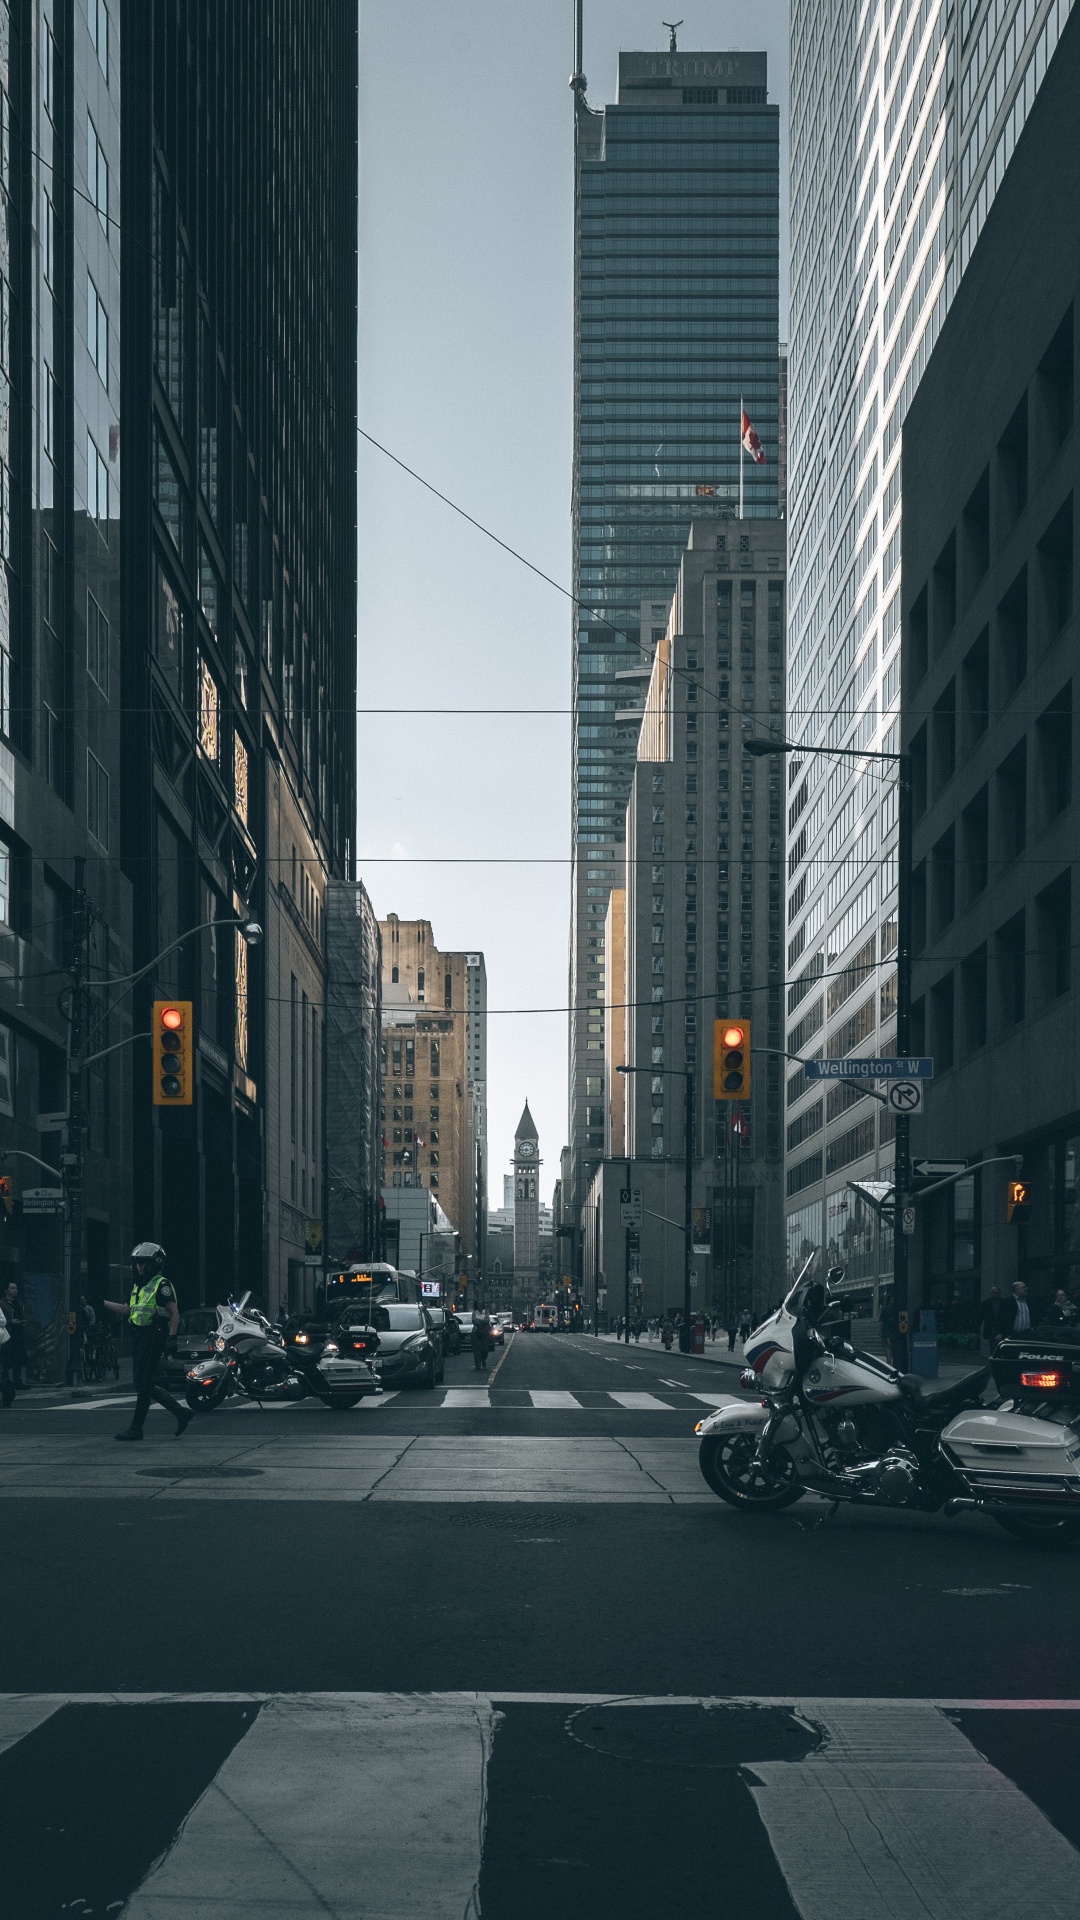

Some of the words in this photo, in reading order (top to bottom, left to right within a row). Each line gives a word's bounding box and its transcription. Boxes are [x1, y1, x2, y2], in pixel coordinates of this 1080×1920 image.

[645, 59, 739, 77] TRUMP
[818, 1061, 892, 1077] Wellington
[908, 1061, 920, 1074] W
[740, 1171, 781, 1182] BANK
[22, 1199, 55, 1207] Wellington
